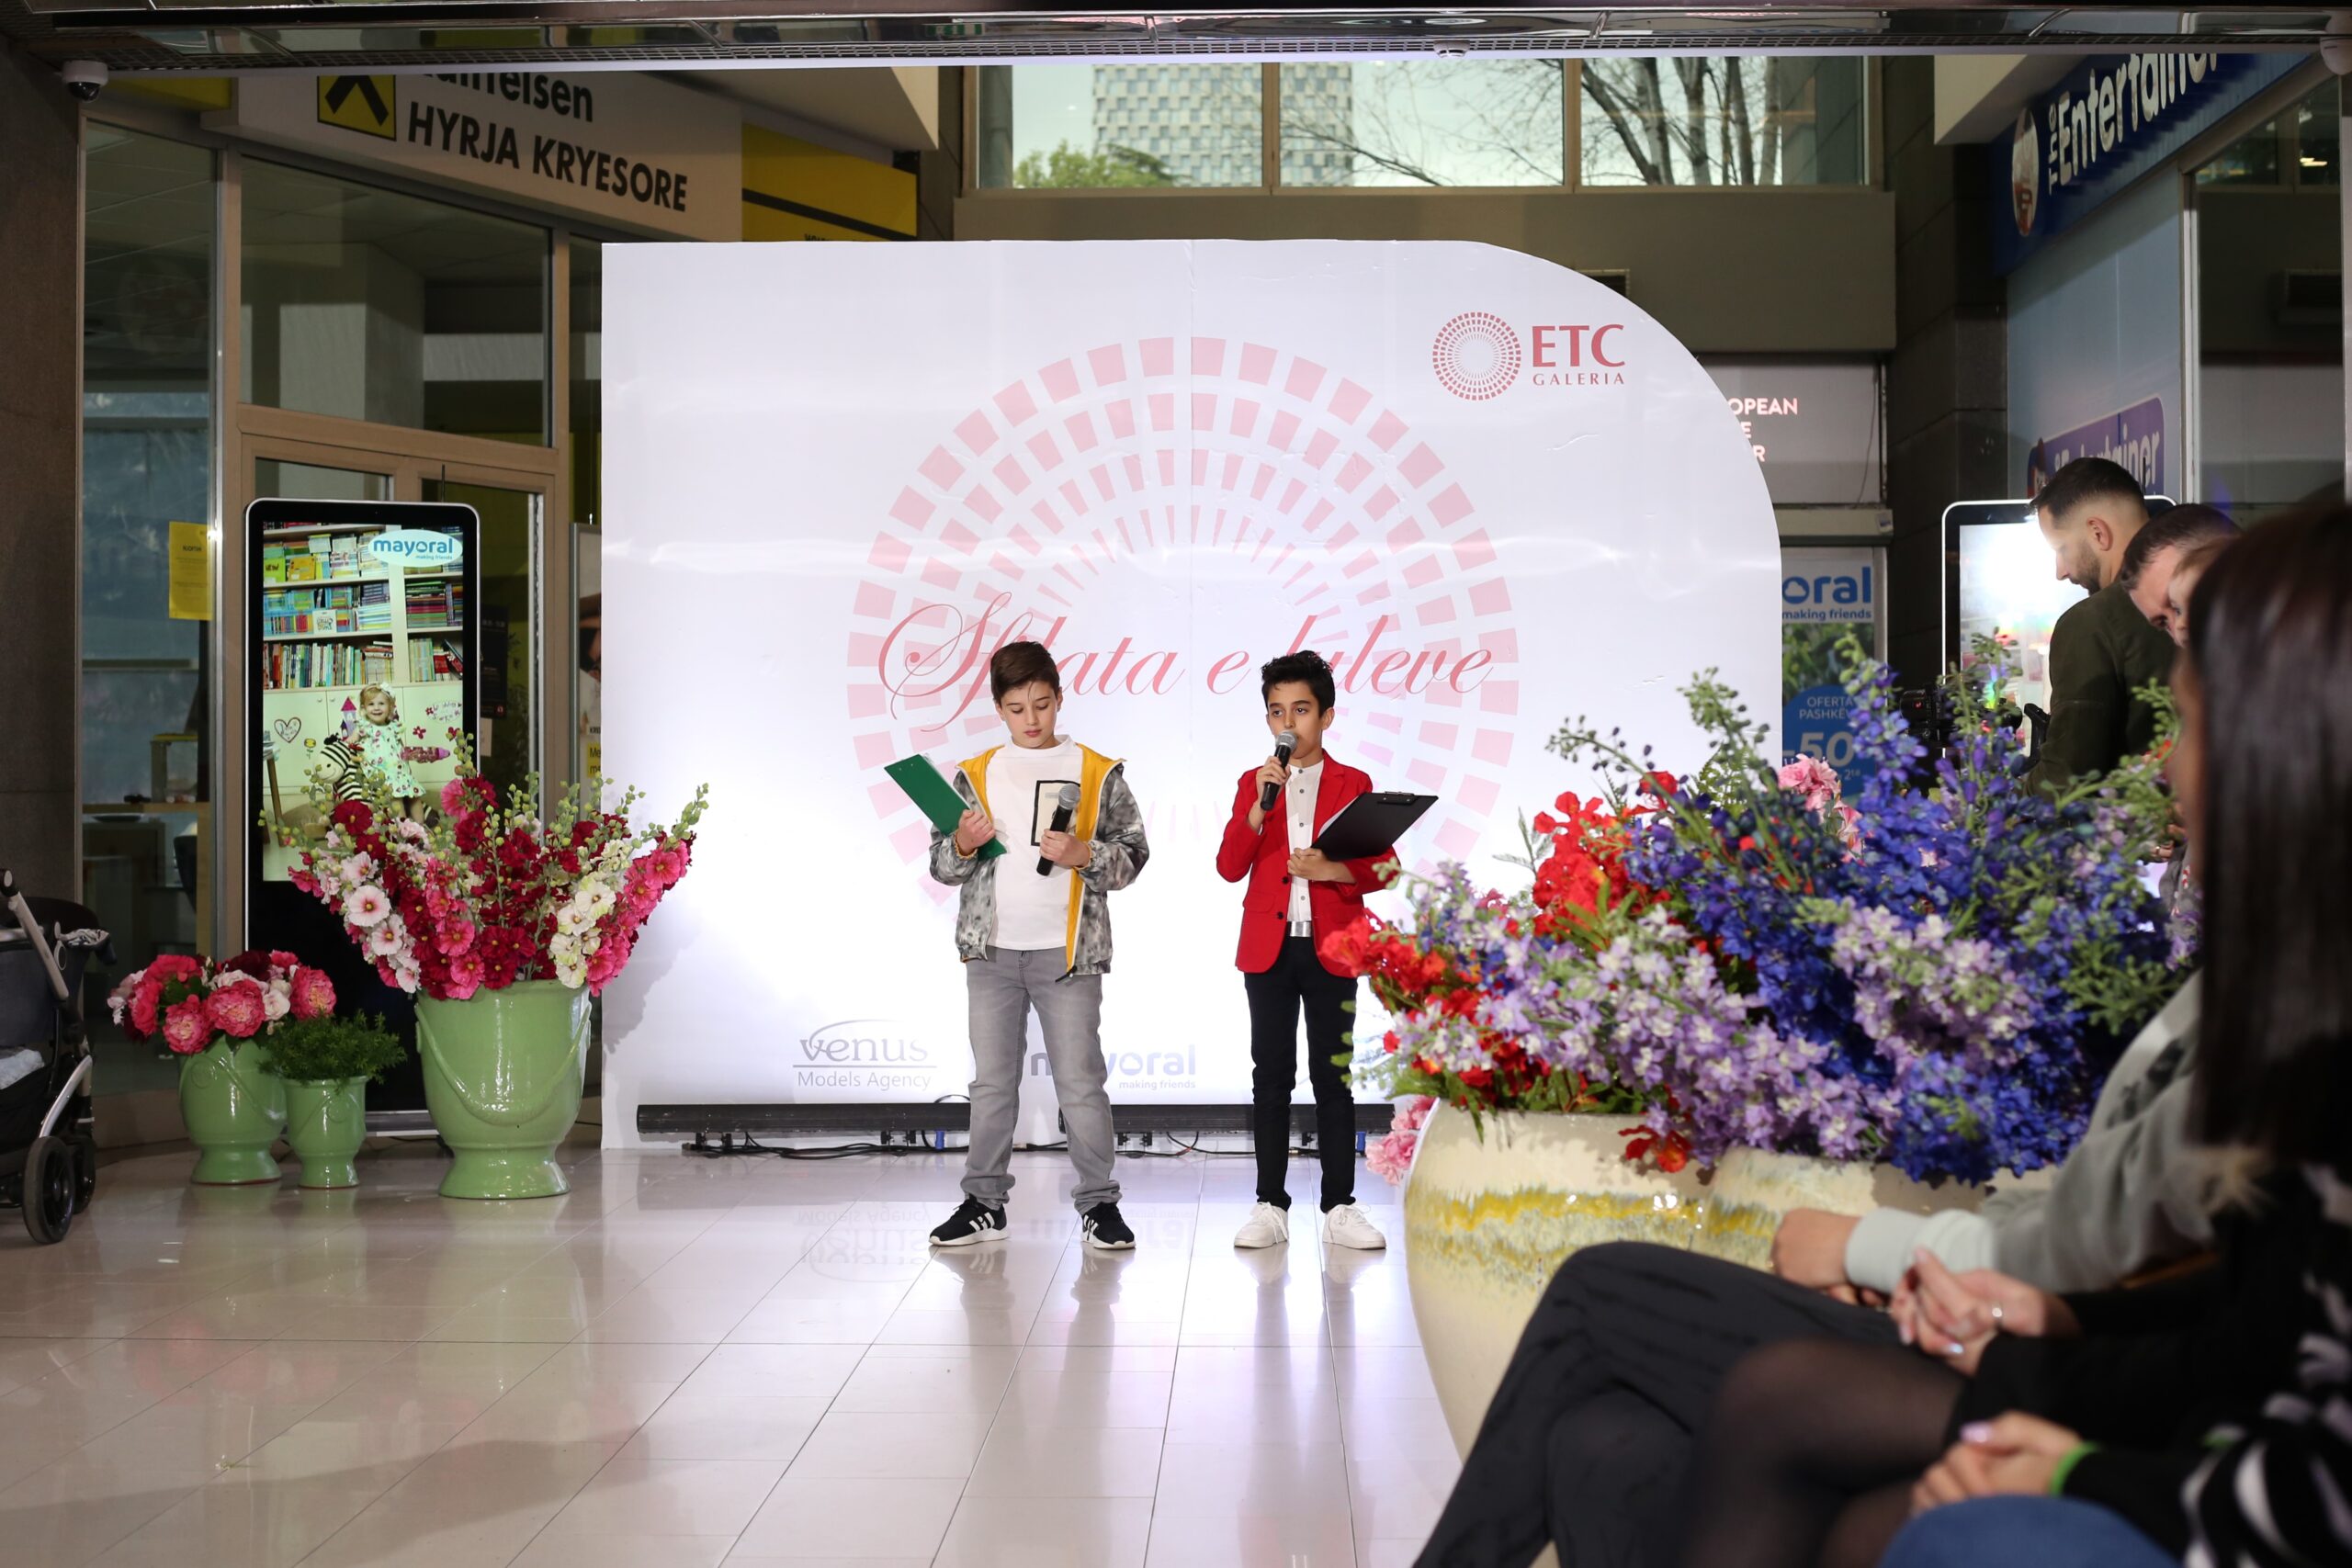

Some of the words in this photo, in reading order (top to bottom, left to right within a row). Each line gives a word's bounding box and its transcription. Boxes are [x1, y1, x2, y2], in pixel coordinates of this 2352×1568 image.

[423, 72, 593, 122] eisen
[2059, 53, 2217, 186] Entertain
[408, 101, 520, 169] HYRJA
[532, 135, 687, 212] KRYESORE
[1532, 323, 1625, 367] ETC
[1532, 372, 1625, 386] GALERIA
[373, 538, 453, 557] mayoral
[1781, 608, 1826, 621] making
[1829, 607, 1871, 619] friends
[878, 592, 1186, 731] Sfata
[1206, 649, 1251, 694] e
[1806, 695, 1854, 707] OFERTA
[797, 1071, 861, 1087] Models
[867, 1072, 932, 1091] Agency
[1119, 1079, 1158, 1090] making
[1160, 1079, 1196, 1089] friends
